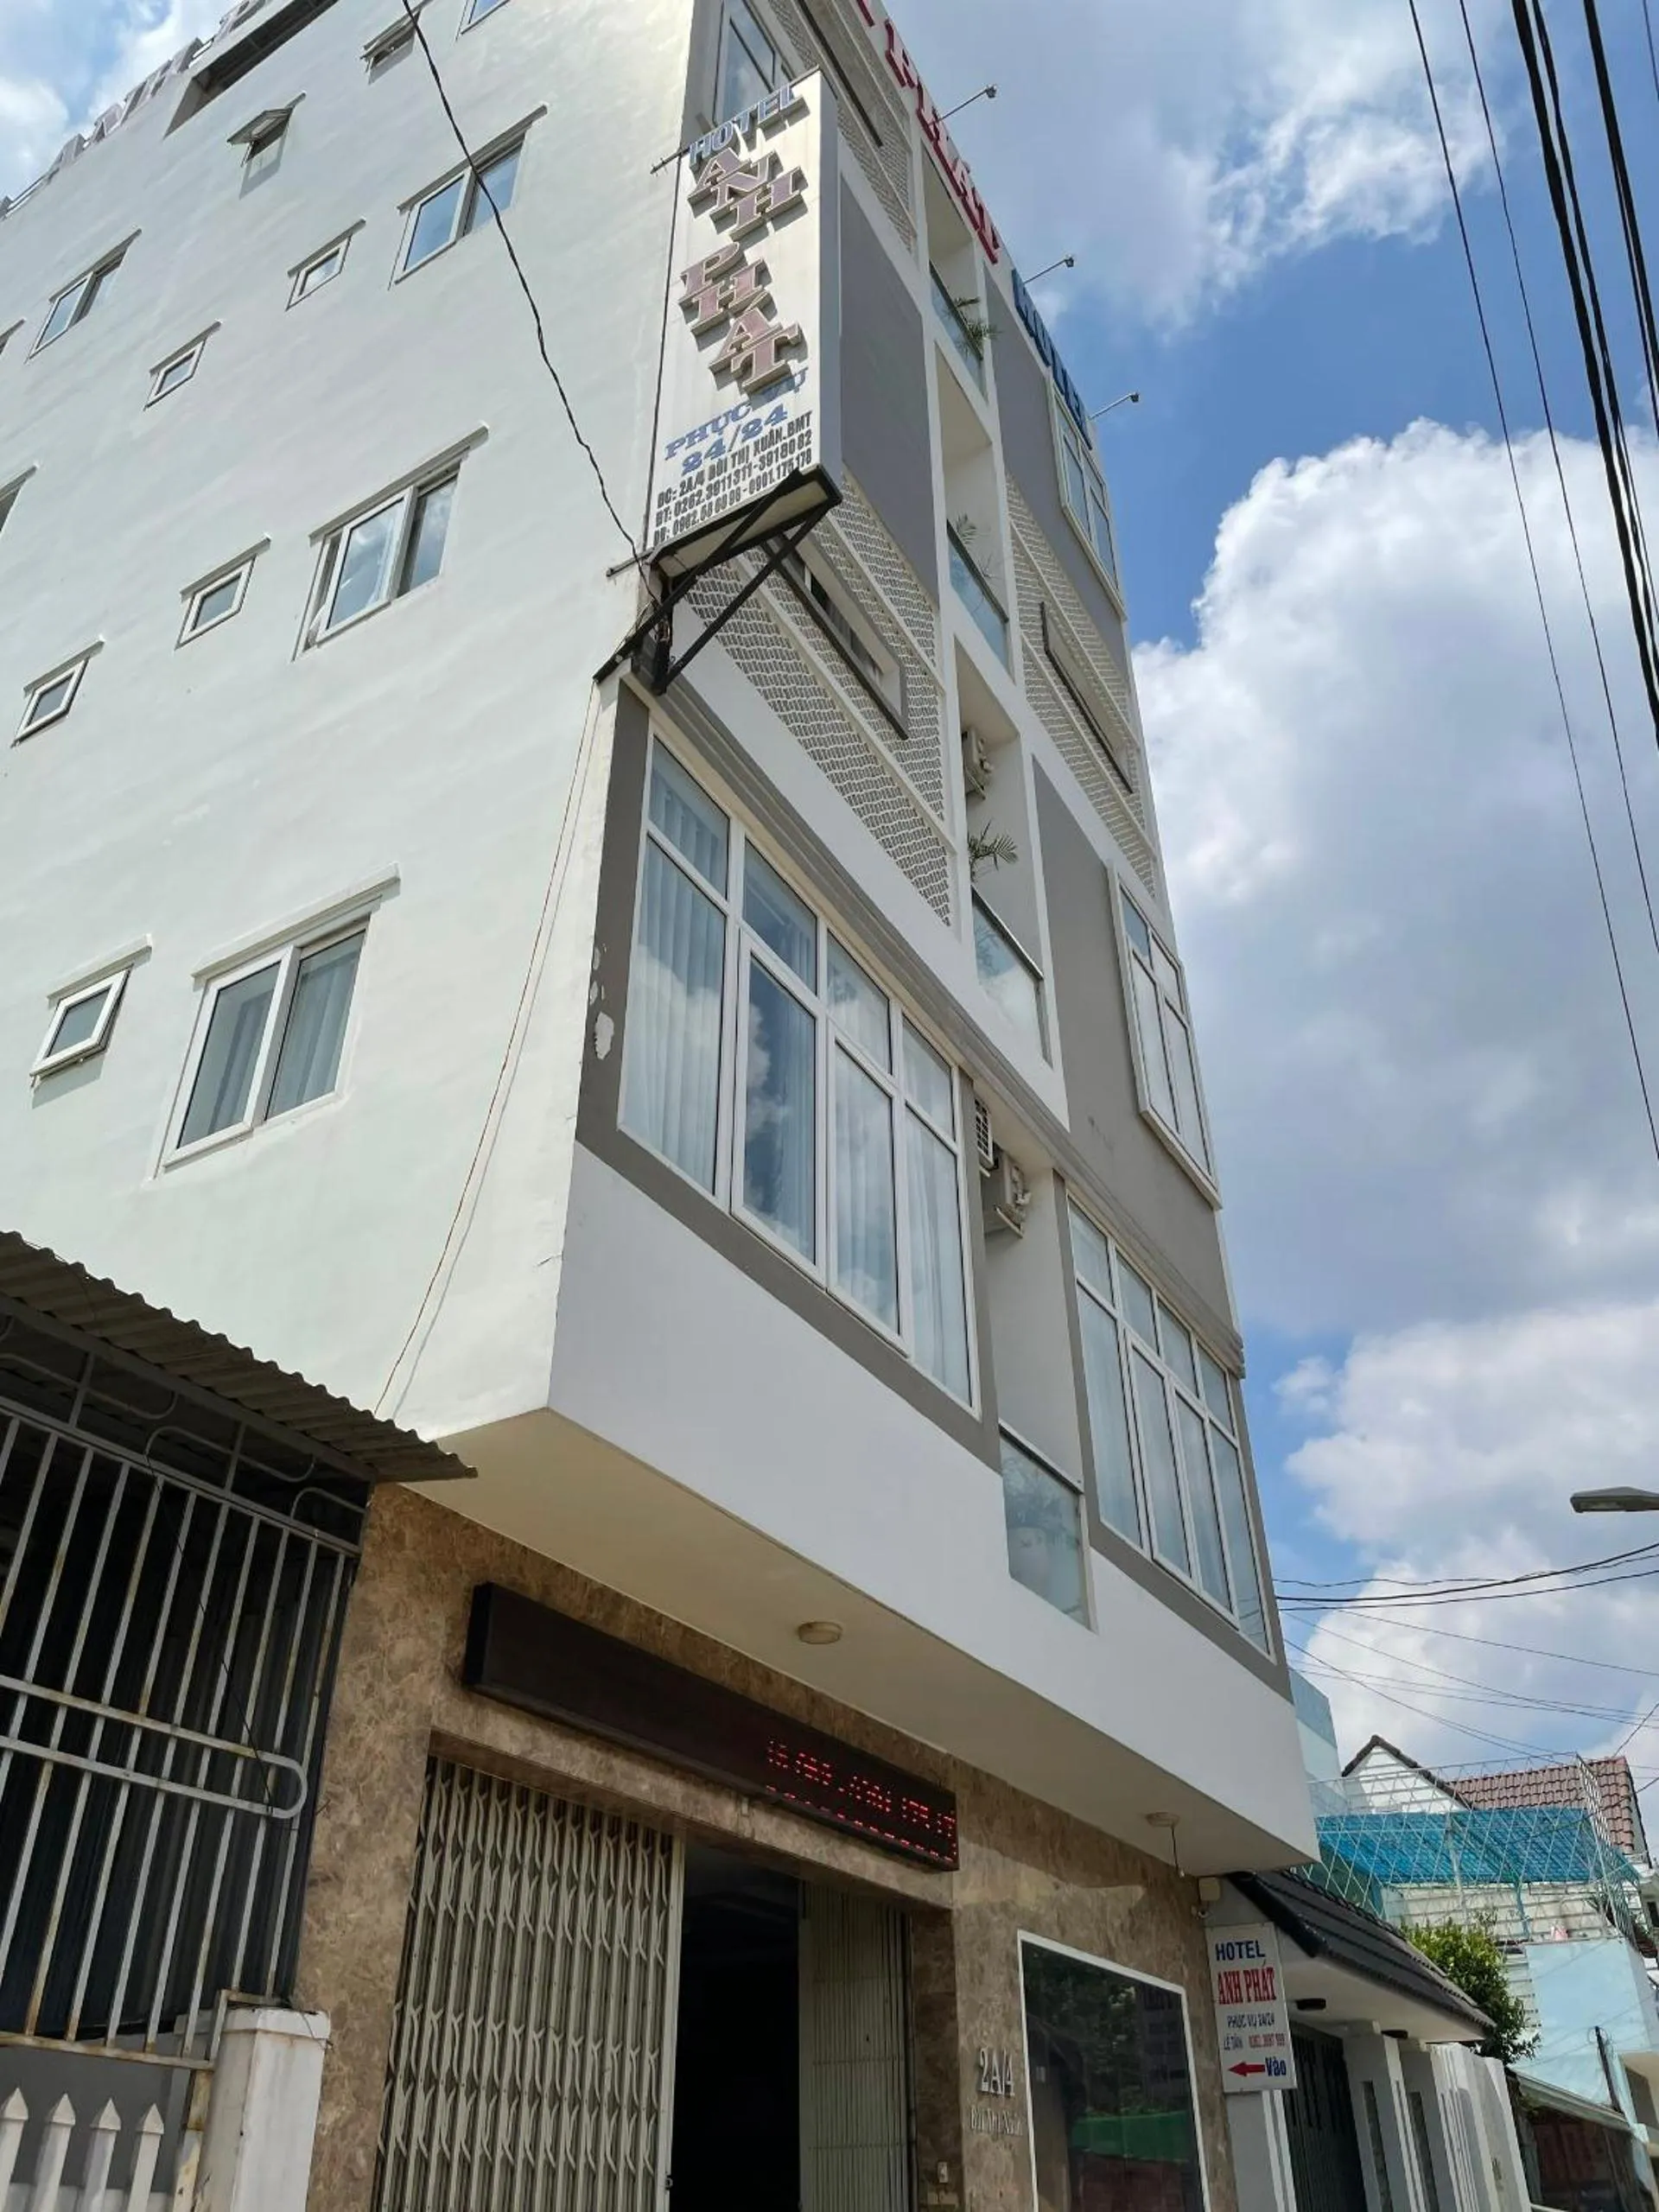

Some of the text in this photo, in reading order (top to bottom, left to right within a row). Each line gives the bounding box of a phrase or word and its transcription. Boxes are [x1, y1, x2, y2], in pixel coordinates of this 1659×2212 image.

[690, 85, 805, 167] HOTEL
[682, 404, 788, 476] 24/24
[1215, 1940, 1266, 1961] HOTEL
[1217, 1959, 1277, 2005] ANH PHÁT
[980, 2046, 1016, 2097] 2A/4
[1265, 2056, 1287, 2077] Vào
